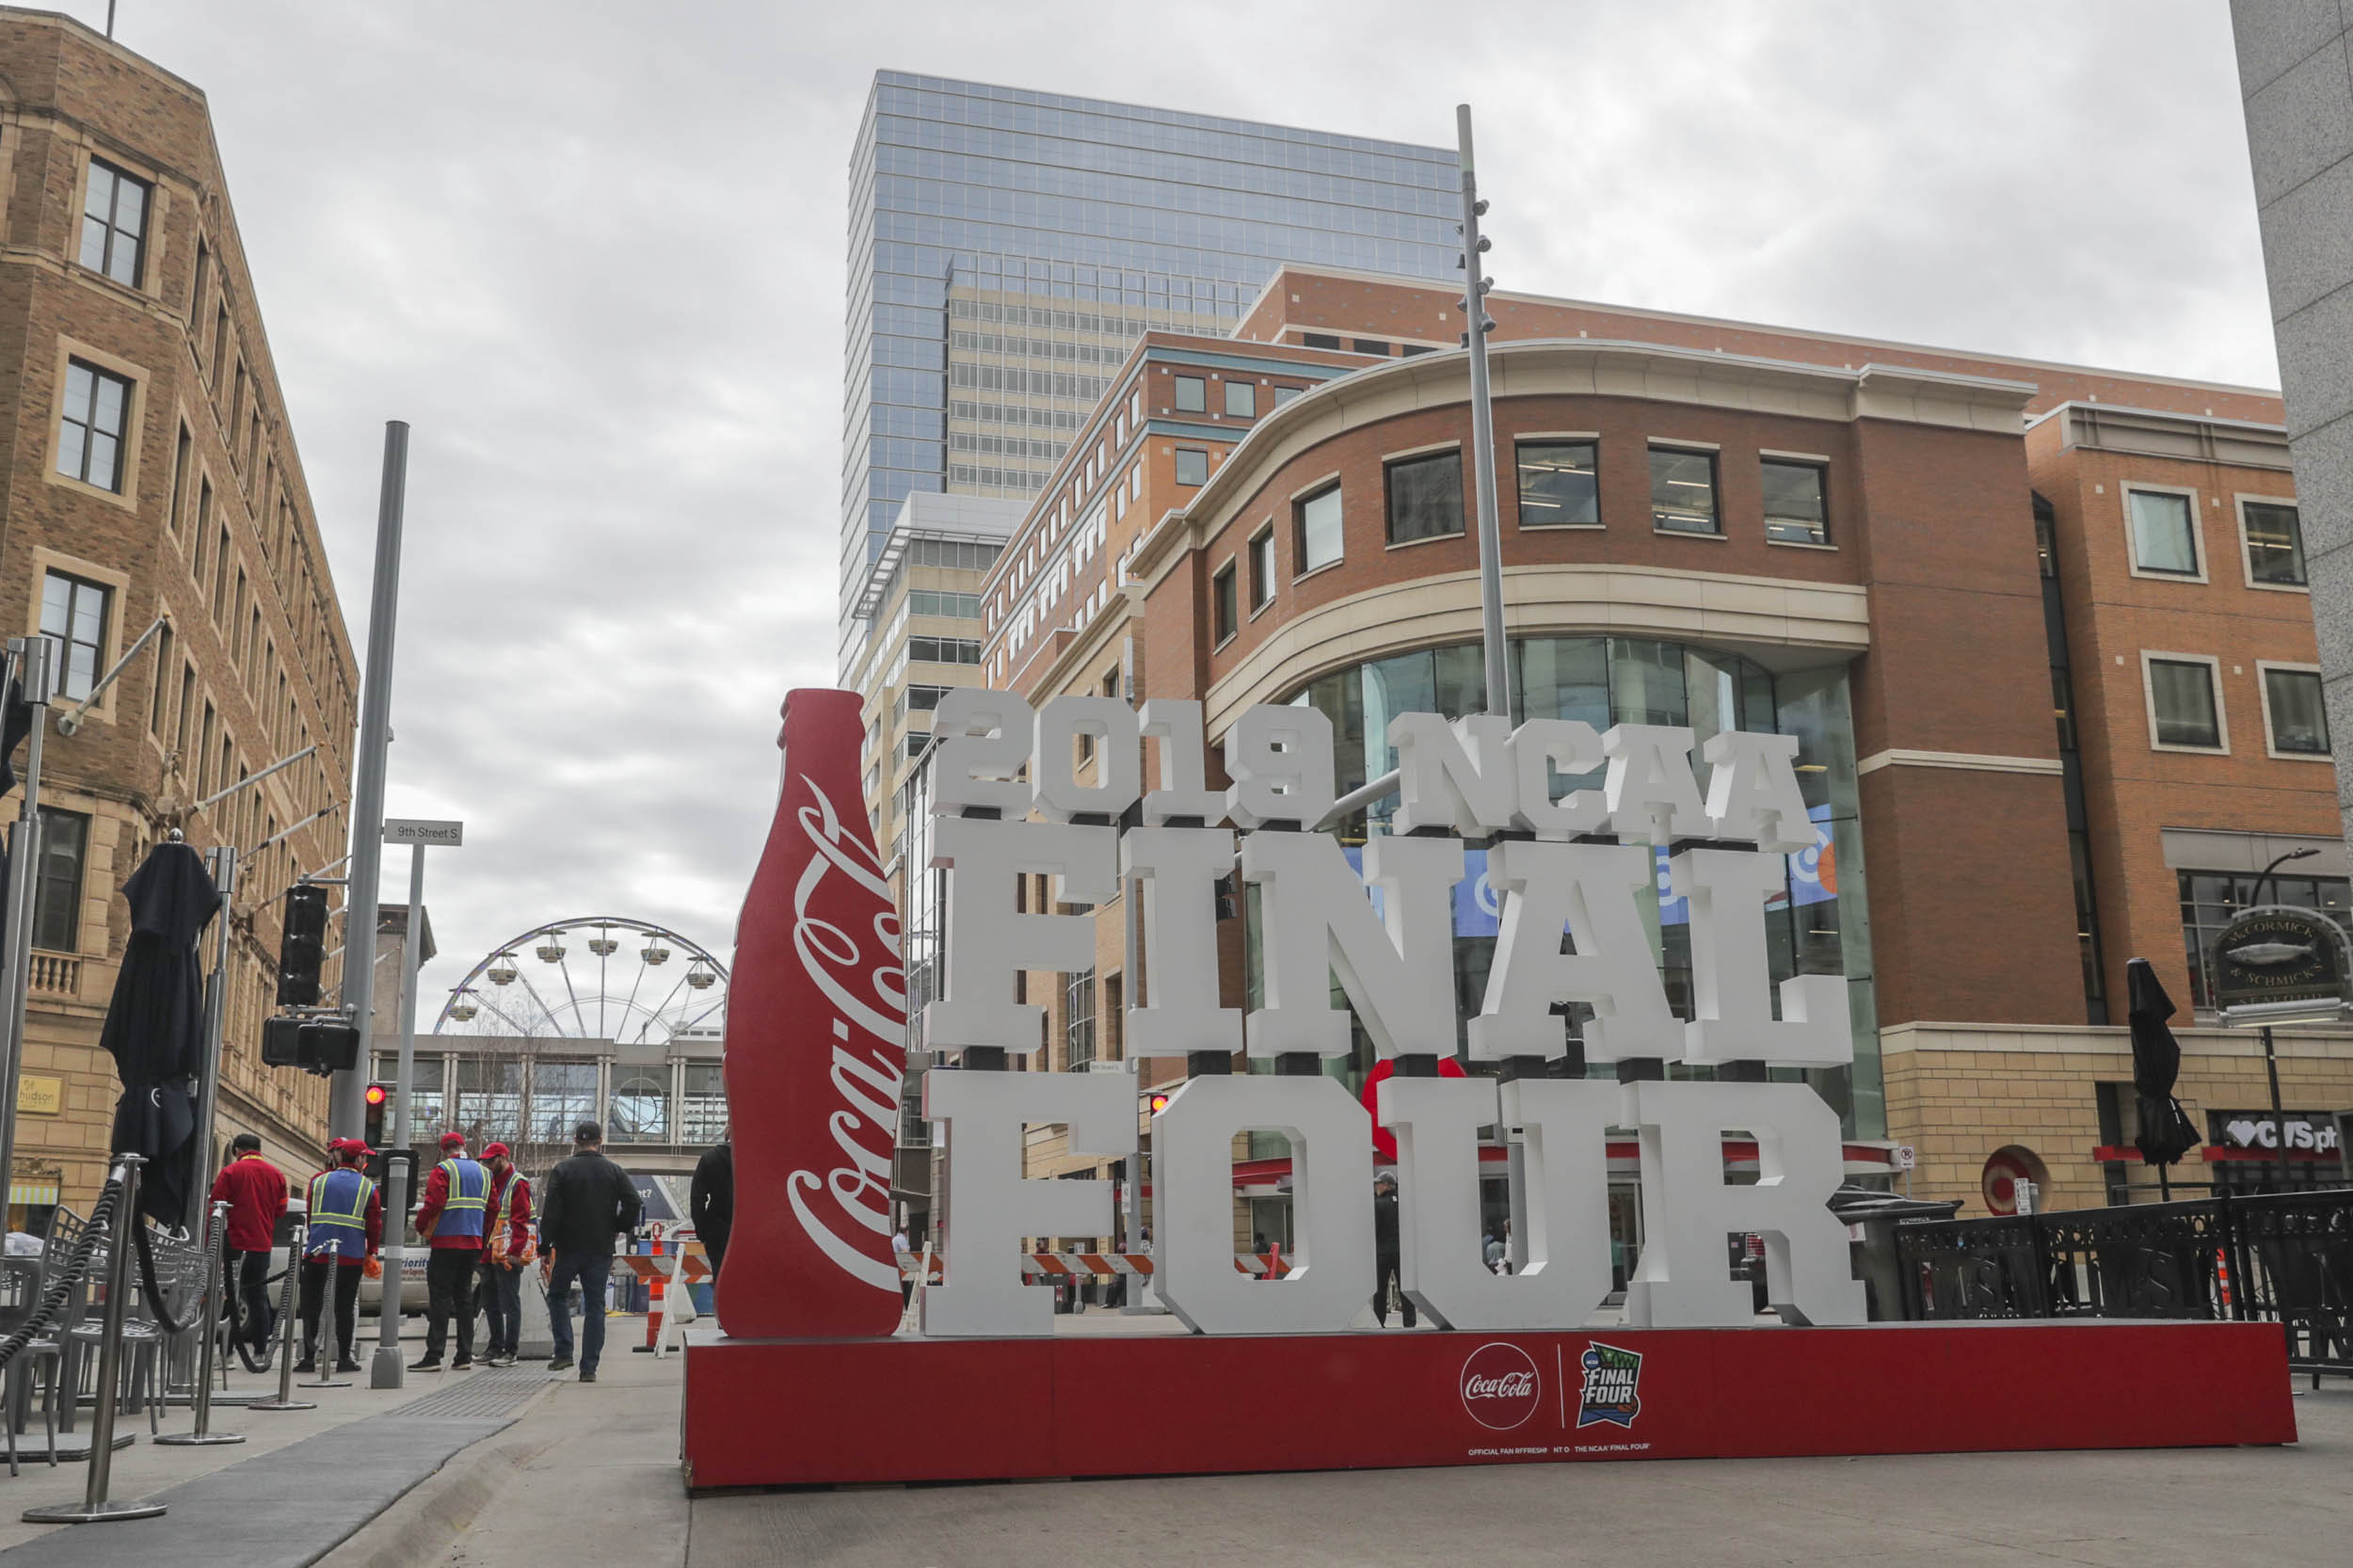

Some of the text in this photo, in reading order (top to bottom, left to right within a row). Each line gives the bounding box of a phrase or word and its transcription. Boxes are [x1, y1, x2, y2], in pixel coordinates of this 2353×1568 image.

[930, 688, 1817, 852] 2019 NCAA
[398, 826, 415, 837] 9th
[418, 826, 448, 838] Street
[923, 816, 1853, 1067] FINAL
[921, 1069, 1871, 1339] FOUR
[1465, 1371, 1535, 1400] Coca-Cola
[1588, 1368, 1635, 1386] FINAL
[1585, 1385, 1633, 1403] FOUR
